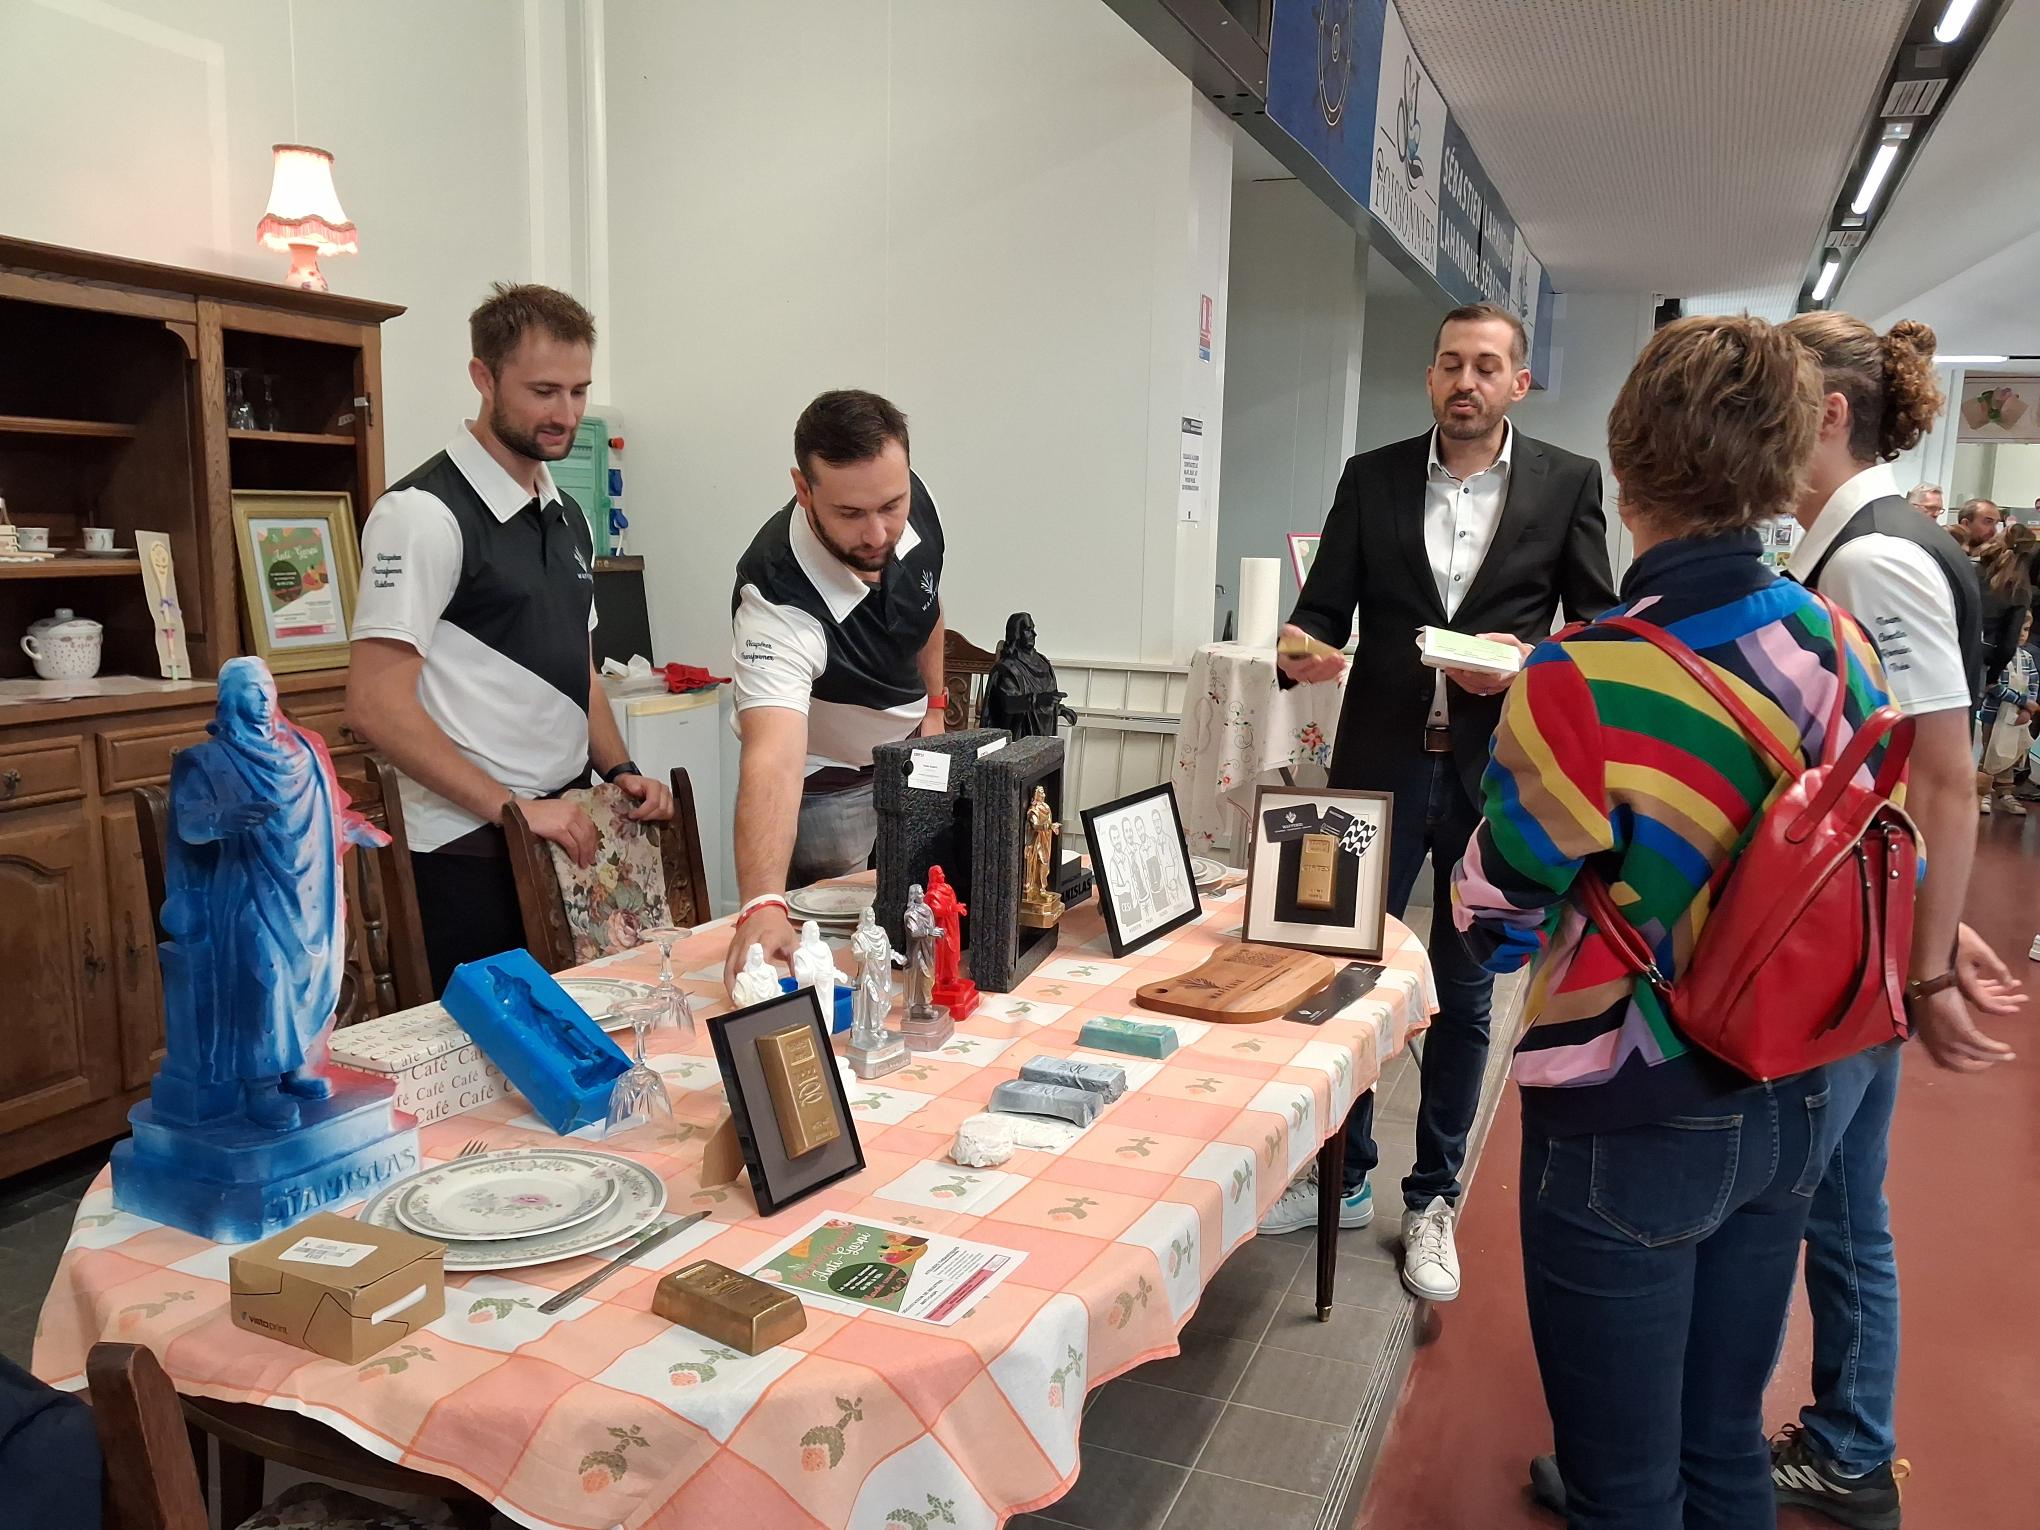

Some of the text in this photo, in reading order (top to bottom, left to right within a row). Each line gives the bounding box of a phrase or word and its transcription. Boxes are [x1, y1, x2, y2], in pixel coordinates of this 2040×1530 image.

[1375, 147, 1436, 267] POISSONNIER
[1442, 146, 1484, 231] SÉBASTIEN
[1439, 210, 1480, 288] LAHANQUE
[395, 1093, 409, 1108] fé
[416, 1081, 445, 1101] Café
[451, 1070, 479, 1089] Café
[411, 1056, 448, 1081] Café
[413, 1083, 495, 1124] Café Café
[811, 1231, 872, 1282] Anti-Gaspi
[248, 1313, 289, 1336] vistaprint
